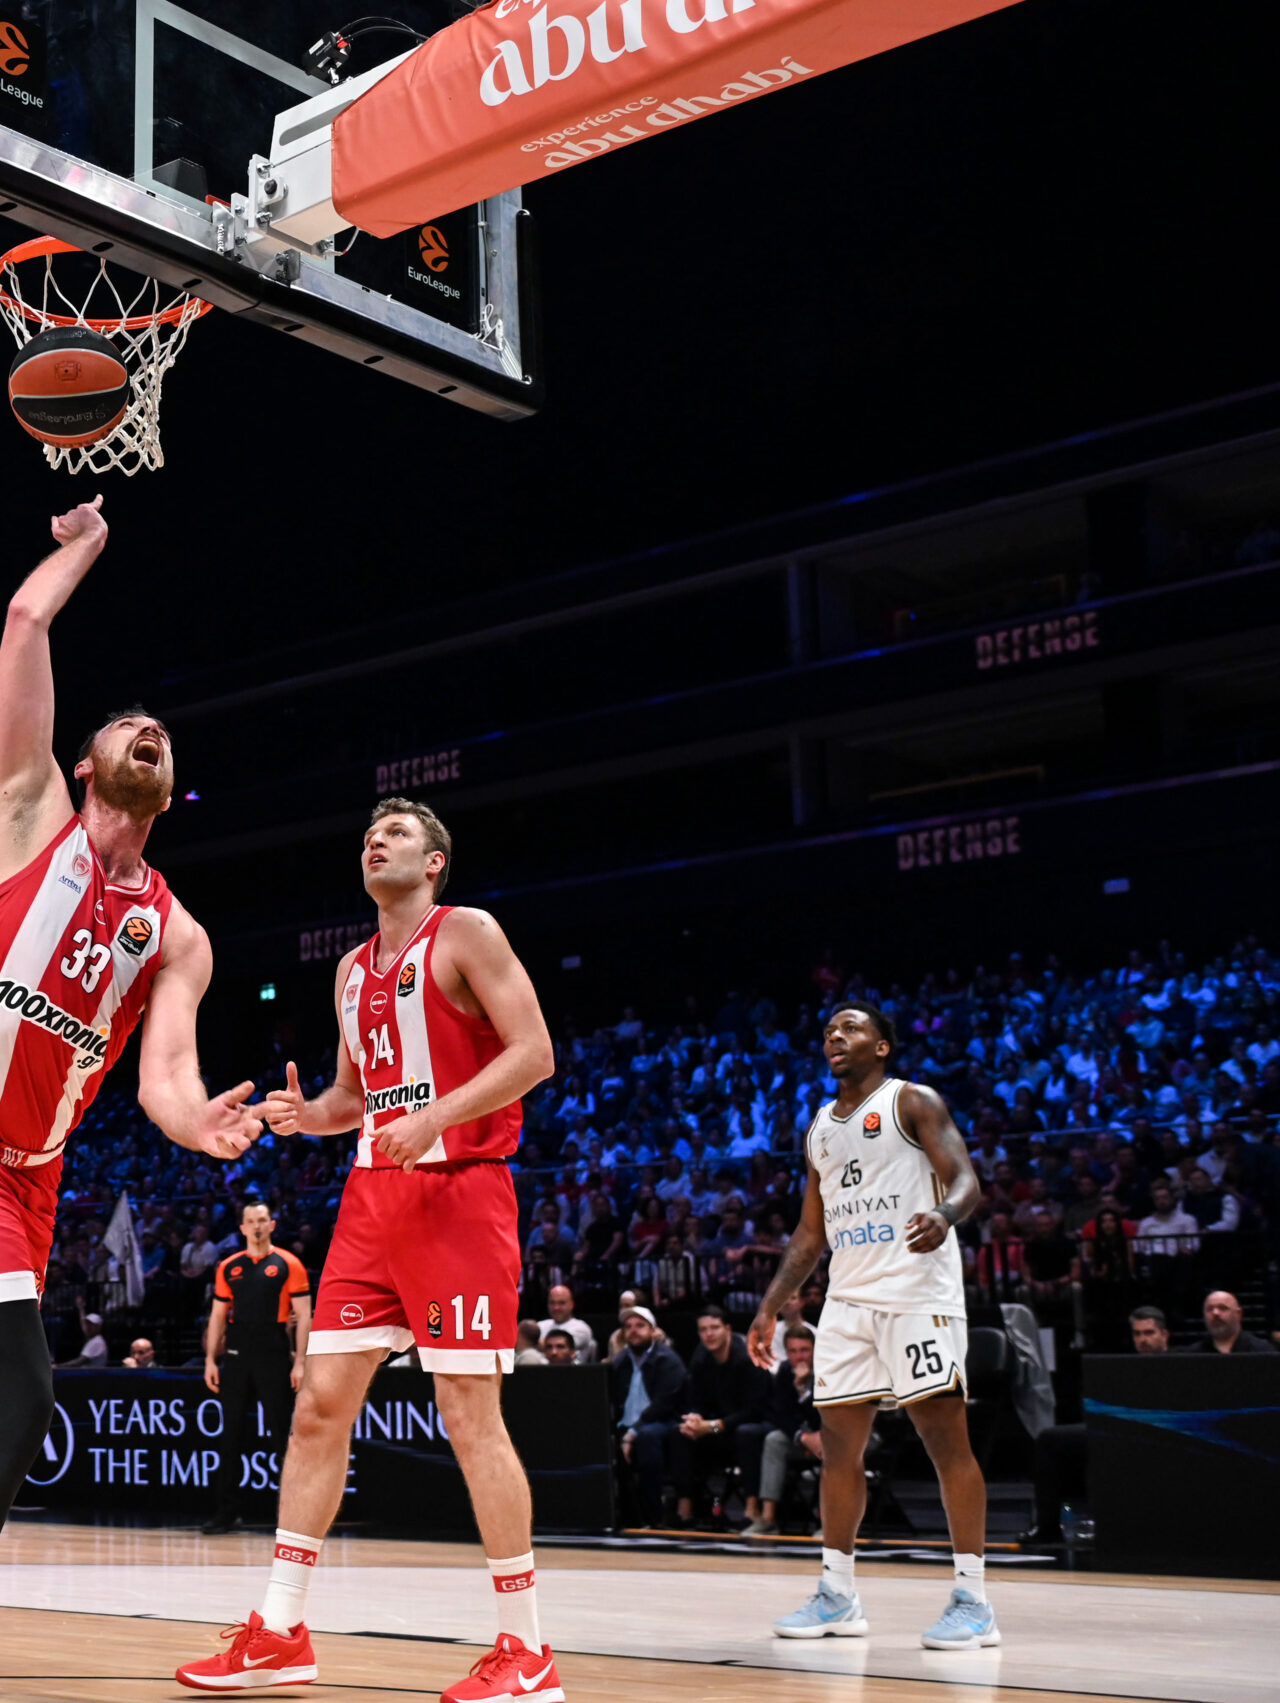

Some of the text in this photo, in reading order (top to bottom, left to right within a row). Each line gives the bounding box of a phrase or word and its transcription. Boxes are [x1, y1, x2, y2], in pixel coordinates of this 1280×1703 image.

[520, 95, 658, 152] experience
[544, 56, 815, 168] abu dhabi
[407, 266, 460, 299] EuroLeague
[976, 611, 1100, 669] DEFENSE
[376, 749, 460, 794] DEFENSE
[898, 816, 1020, 870] DEFENSE
[60, 928, 112, 993] 33
[300, 921, 380, 962] DEFENS
[368, 1023, 395, 1070] 14
[840, 1158, 862, 1189] 25
[824, 1195, 900, 1223] OMNIYAT
[451, 1294, 492, 1340] 14
[905, 1339, 943, 1380] 25
[88, 1399, 186, 1436] YEARS
[88, 1448, 149, 1485] THE
[278, 1547, 314, 1565] GSA
